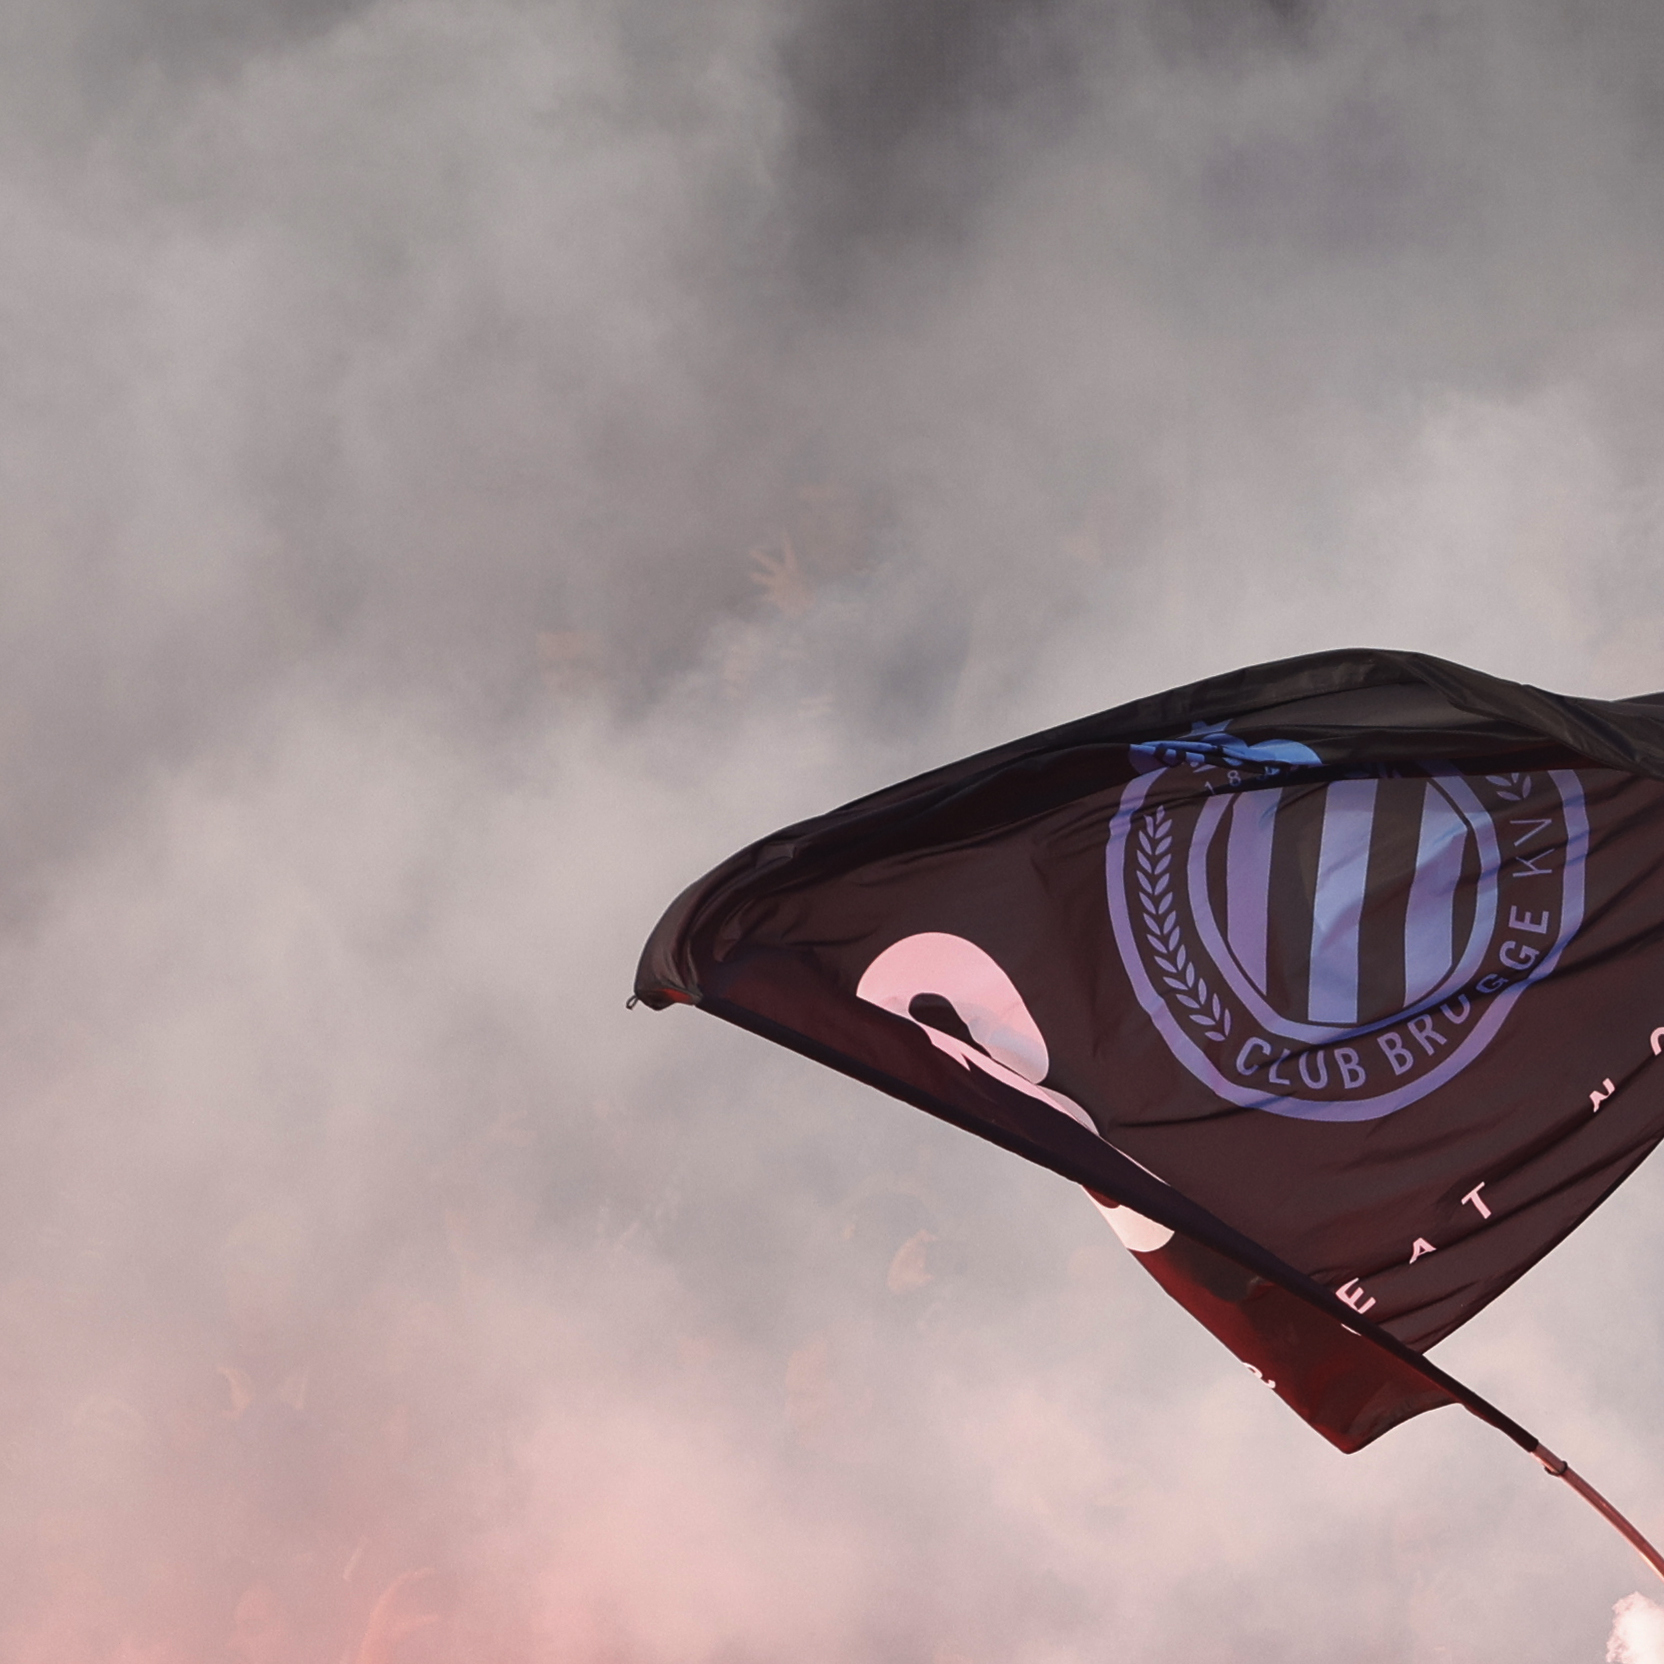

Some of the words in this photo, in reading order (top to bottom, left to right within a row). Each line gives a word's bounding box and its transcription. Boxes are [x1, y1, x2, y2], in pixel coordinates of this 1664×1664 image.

[1235, 1035, 1366, 1090] CLUB
[1376, 905, 1551, 1076] BRUGGE
[1509, 817, 1556, 878] KV
